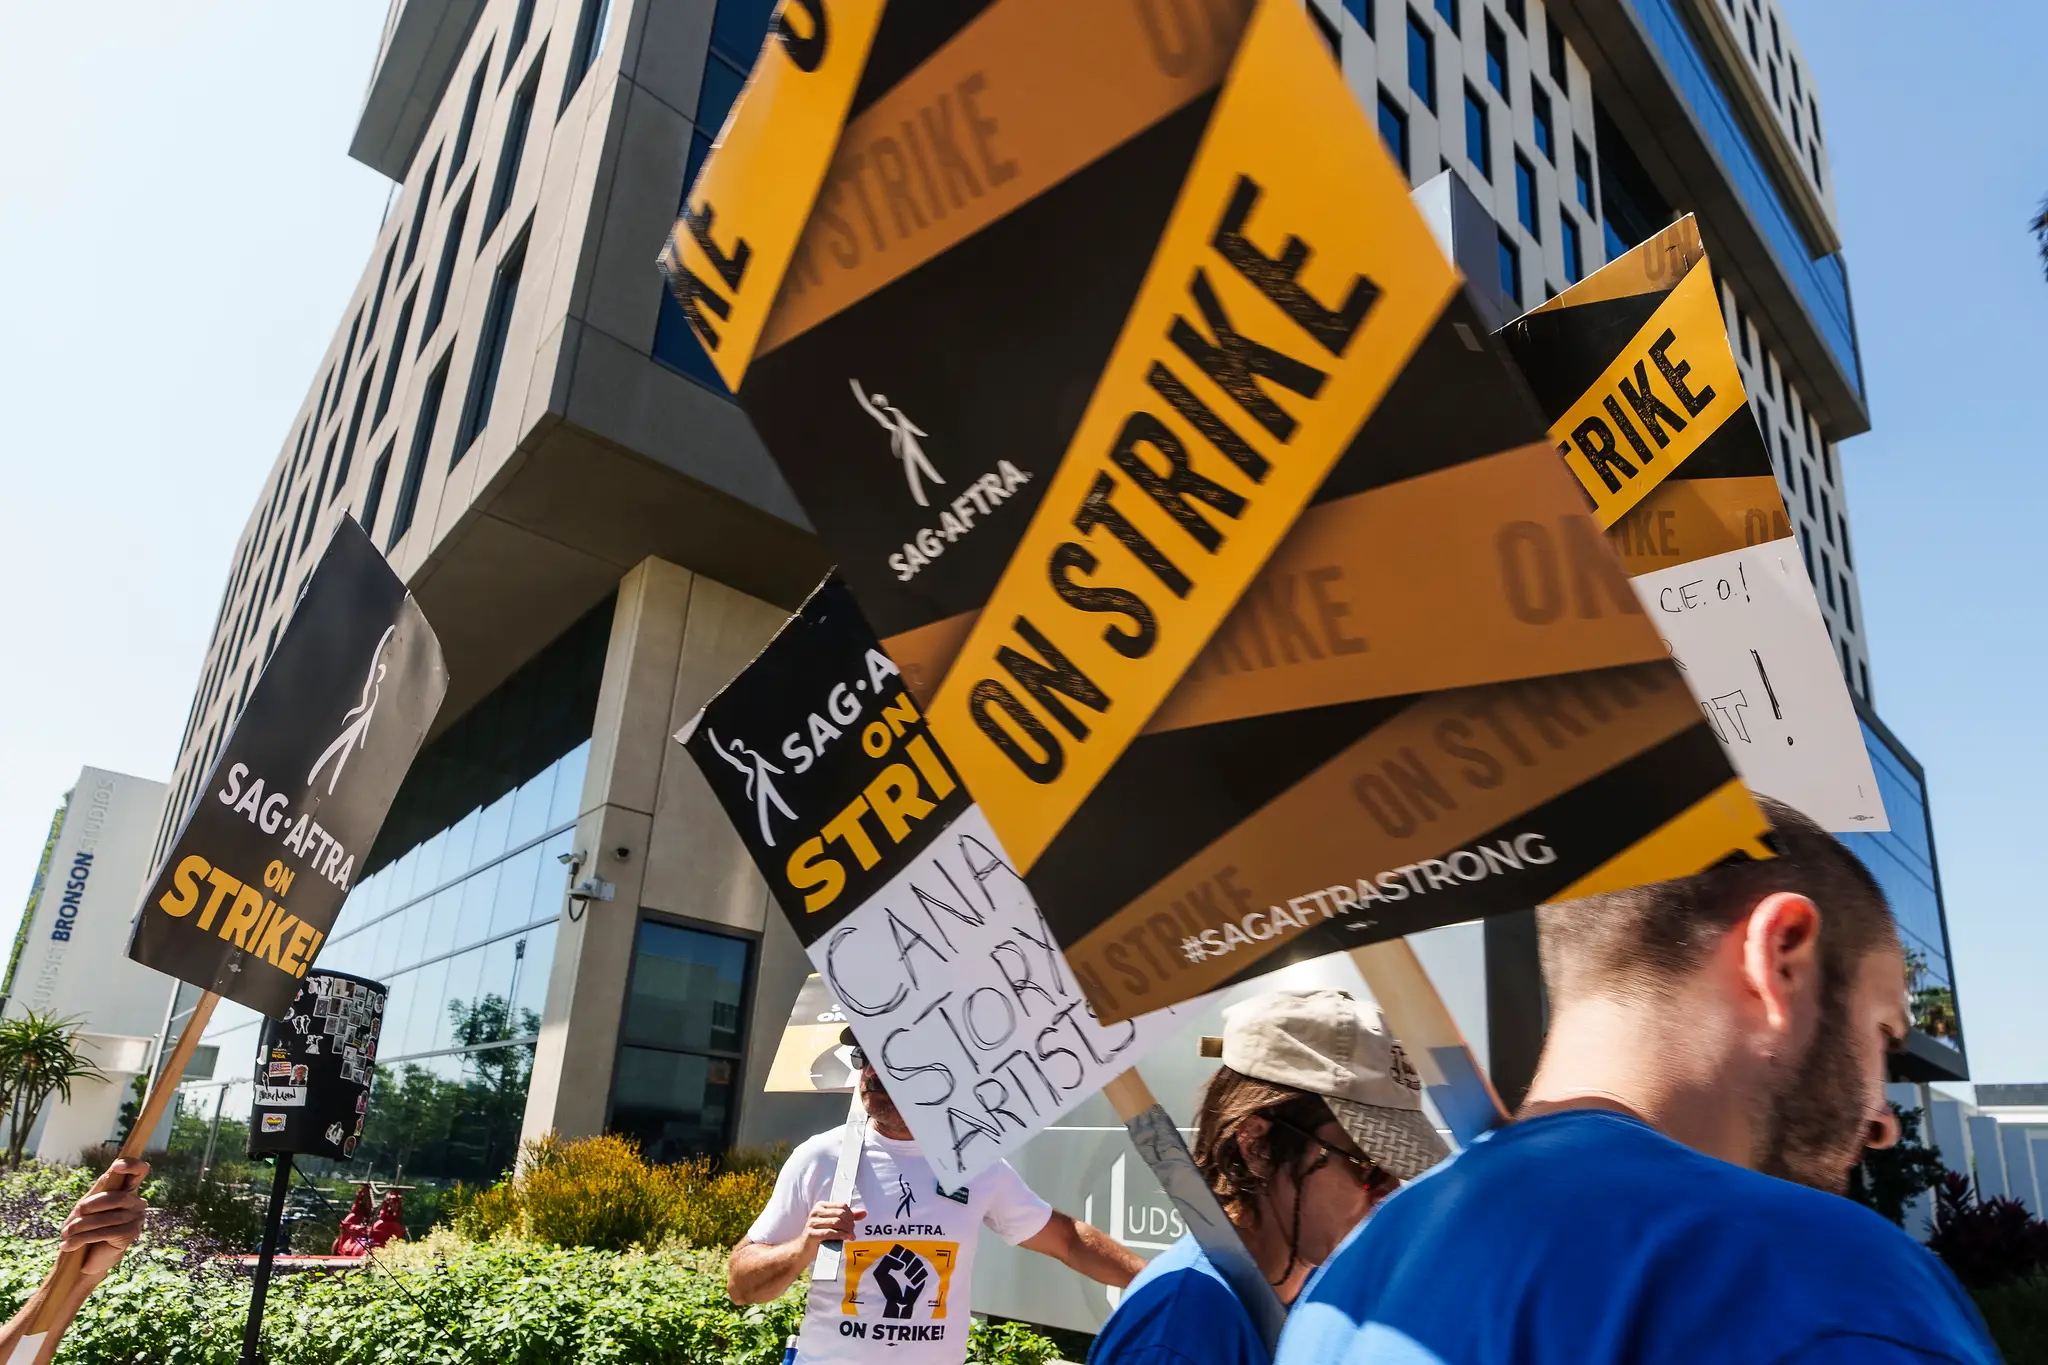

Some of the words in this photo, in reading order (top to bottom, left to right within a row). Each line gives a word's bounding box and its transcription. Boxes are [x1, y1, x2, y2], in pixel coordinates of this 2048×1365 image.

[968, 614, 1112, 785] ON
[1048, 173, 1384, 660] STRIKE
[862, 692, 921, 758] ON
[1354, 745, 1459, 839] ON
[51, 852, 94, 942] BRONSON
[159, 855, 324, 979] STRIKE!
[264, 860, 295, 897] ON
[1180, 832, 1558, 964] #SAGAFTRASTRONG
[881, 906, 1068, 1106] STORY
[839, 1320, 868, 1339] ON
[871, 1323, 946, 1341] STRIKE!
